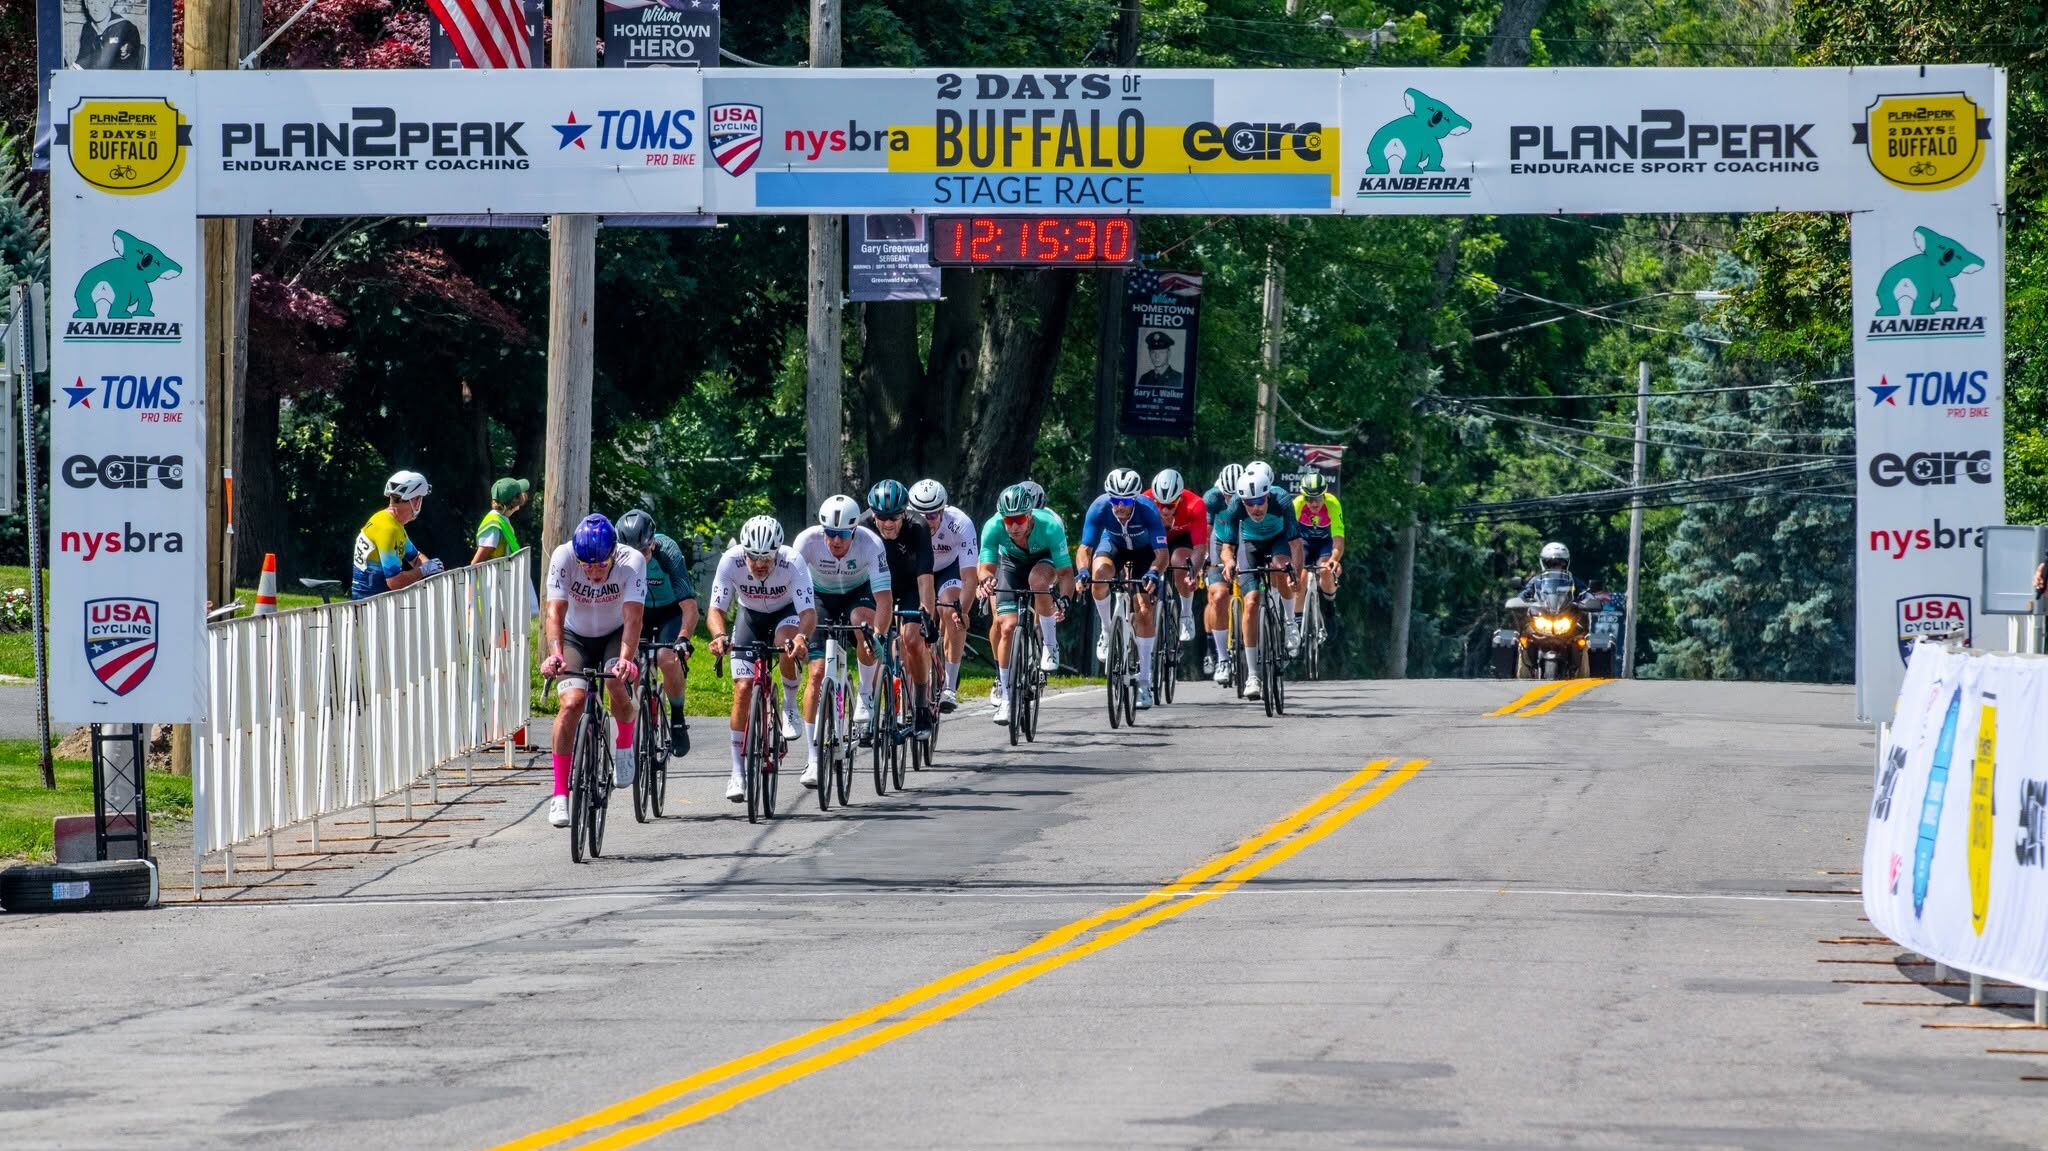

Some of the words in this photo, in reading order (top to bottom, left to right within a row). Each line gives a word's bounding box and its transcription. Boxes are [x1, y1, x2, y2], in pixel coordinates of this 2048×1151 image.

[641, 5, 682, 23] Wilson
[614, 24, 711, 38] HOMETOWN
[630, 39, 695, 57] HERO
[936, 73, 962, 99] 2
[976, 73, 1111, 100] DAYS
[1122, 75, 1142, 94] OF
[90, 111, 157, 122] PLAN2PEAK
[713, 107, 757, 123] USA
[1888, 107, 1955, 120] PLAN2PEAK
[90, 130, 98, 139] 2
[103, 130, 147, 139] DAYS
[222, 107, 528, 157] PLAN2PEAK
[597, 109, 695, 150] TOMS
[713, 122, 758, 132] CYCLING
[1511, 109, 1819, 159] PLAN2PEAK
[1888, 127, 1897, 136] 2
[1901, 126, 1945, 136] DAYS
[784, 120, 909, 161] nysbra
[936, 108, 1145, 168] BUFFALO
[89, 141, 158, 160] BUFFALO
[1888, 136, 1957, 158] BUFFALO
[223, 160, 346, 171] ENDURANCE
[353, 160, 419, 171] SPORT
[425, 159, 530, 171] COACHING
[646, 153, 669, 166] PRO
[672, 153, 695, 165] BIKE
[1510, 162, 1636, 174] ENDURANCE
[1641, 162, 1708, 173] SPORT
[1713, 160, 1820, 173] COACHING
[934, 176, 1042, 204] STAGE
[1055, 176, 1145, 204] RACE
[1358, 176, 1471, 191] KANBERRA
[955, 219, 1129, 260] 12:15:30
[861, 244, 881, 255] Gary
[883, 243, 929, 253] Greenwald
[1132, 303, 1195, 315] HOMETOWN
[66, 321, 181, 336] KANBERRA
[1142, 314, 1184, 327] HERO
[1868, 316, 1984, 334] KANBERRA
[101, 375, 183, 409] TOMS
[1905, 370, 1988, 406] TOMS
[140, 412, 160, 423] PRO
[163, 412, 183, 423] BIKE
[1946, 408, 1966, 418] PRO
[1969, 407, 1989, 417] BIKE
[61, 522, 183, 562] nysbra
[91, 603, 152, 624] USA
[1904, 601, 1965, 621] USA
[91, 625, 152, 636] CYCLING
